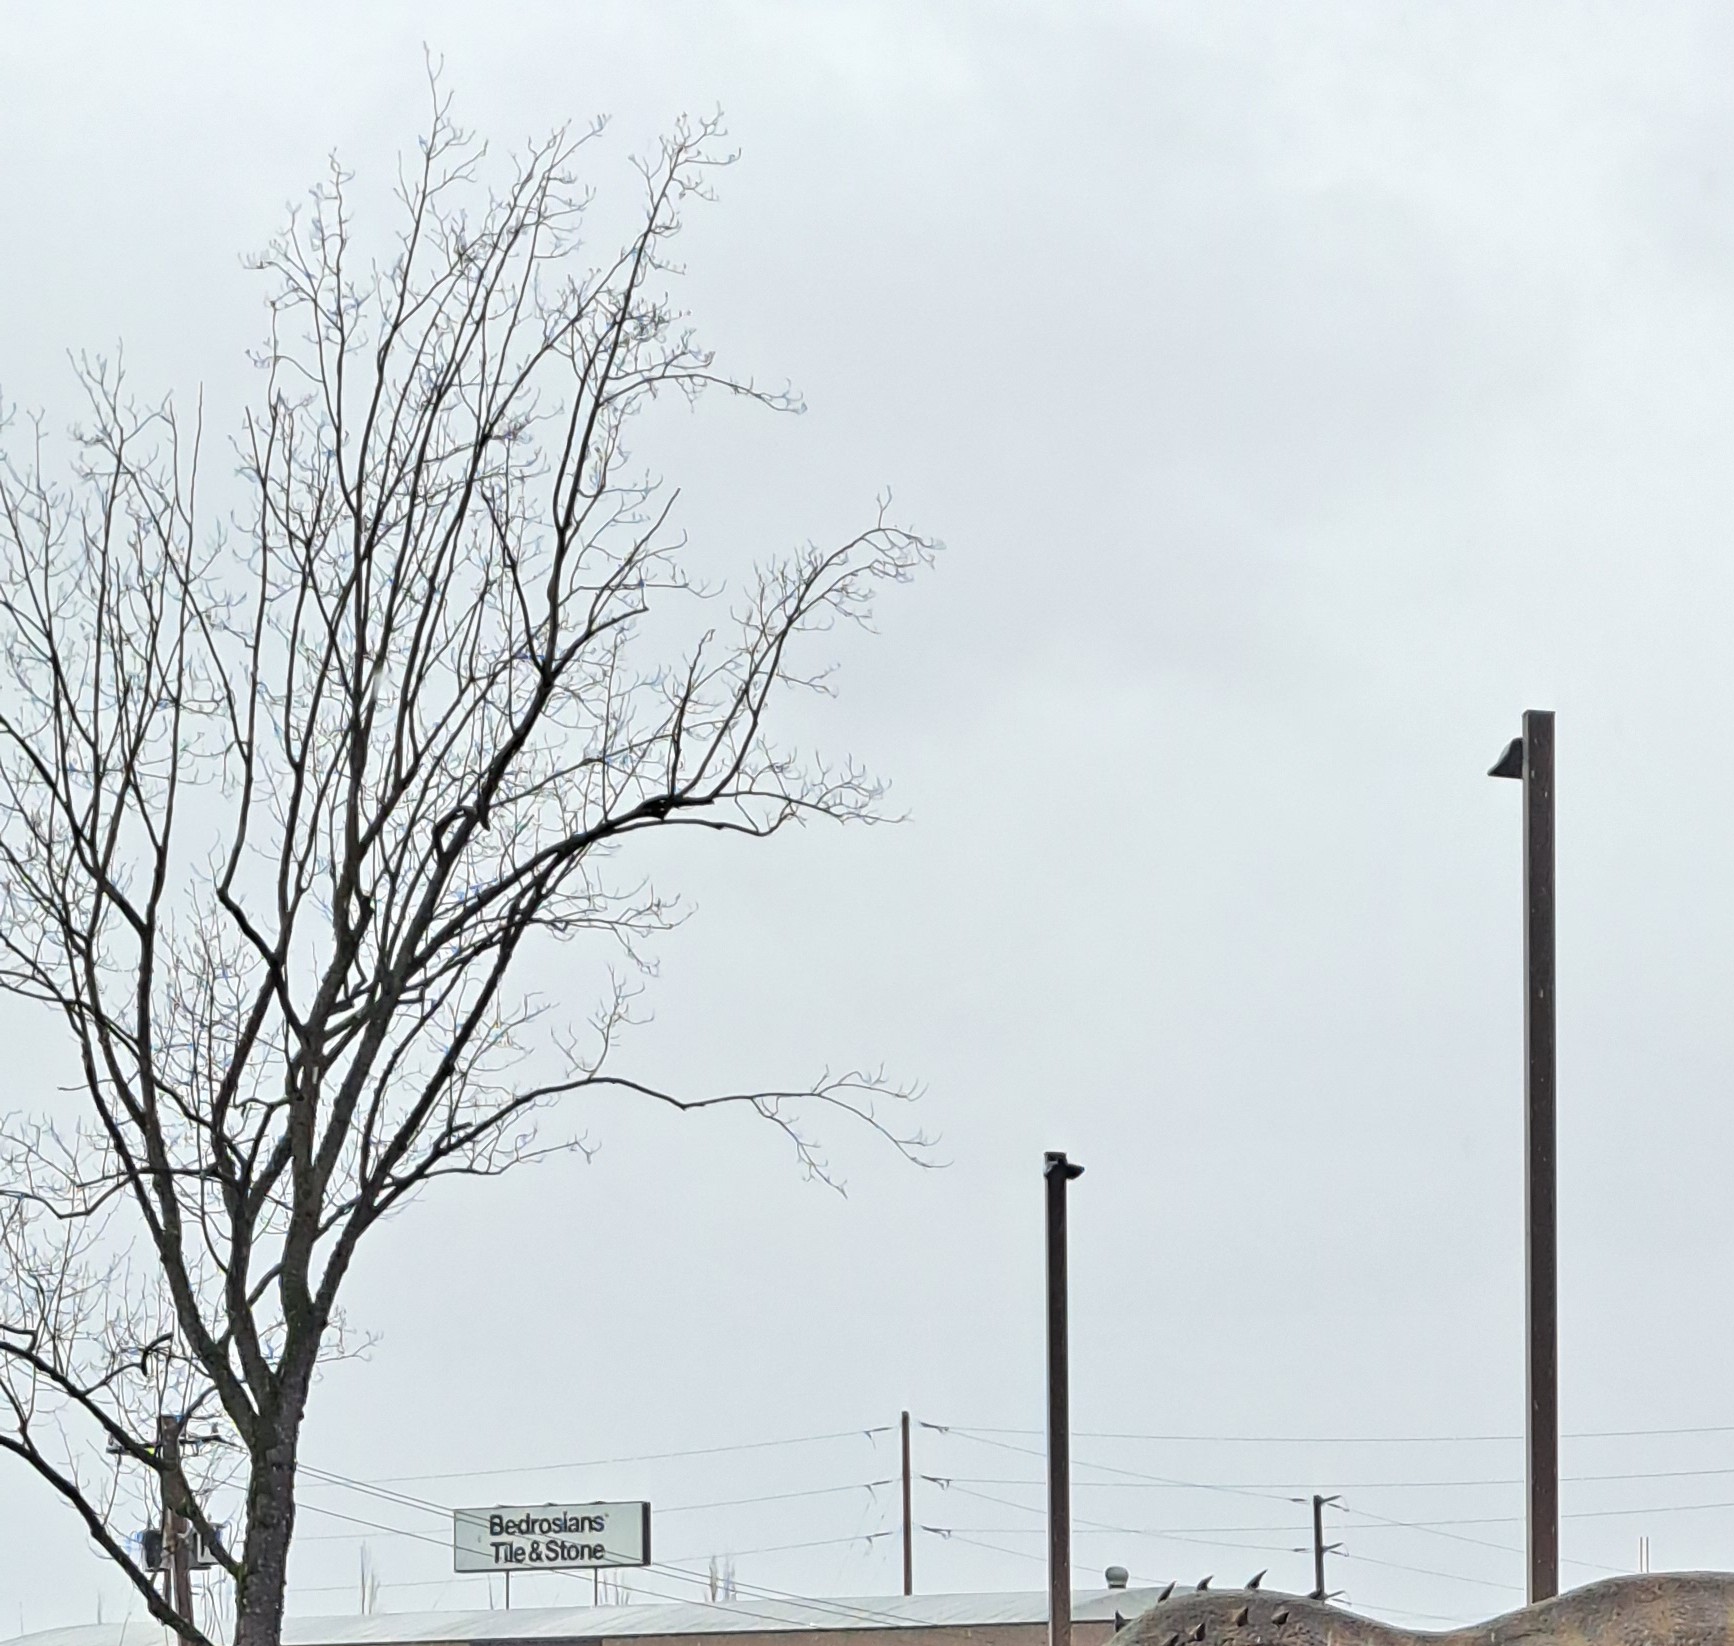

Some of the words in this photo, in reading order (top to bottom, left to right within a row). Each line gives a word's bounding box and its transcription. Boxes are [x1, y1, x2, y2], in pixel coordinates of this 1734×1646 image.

[490, 1511, 606, 1536] Bedrosians
[490, 1541, 526, 1563] Tile
[528, 1541, 544, 1562] &
[545, 1540, 606, 1562] Stone
